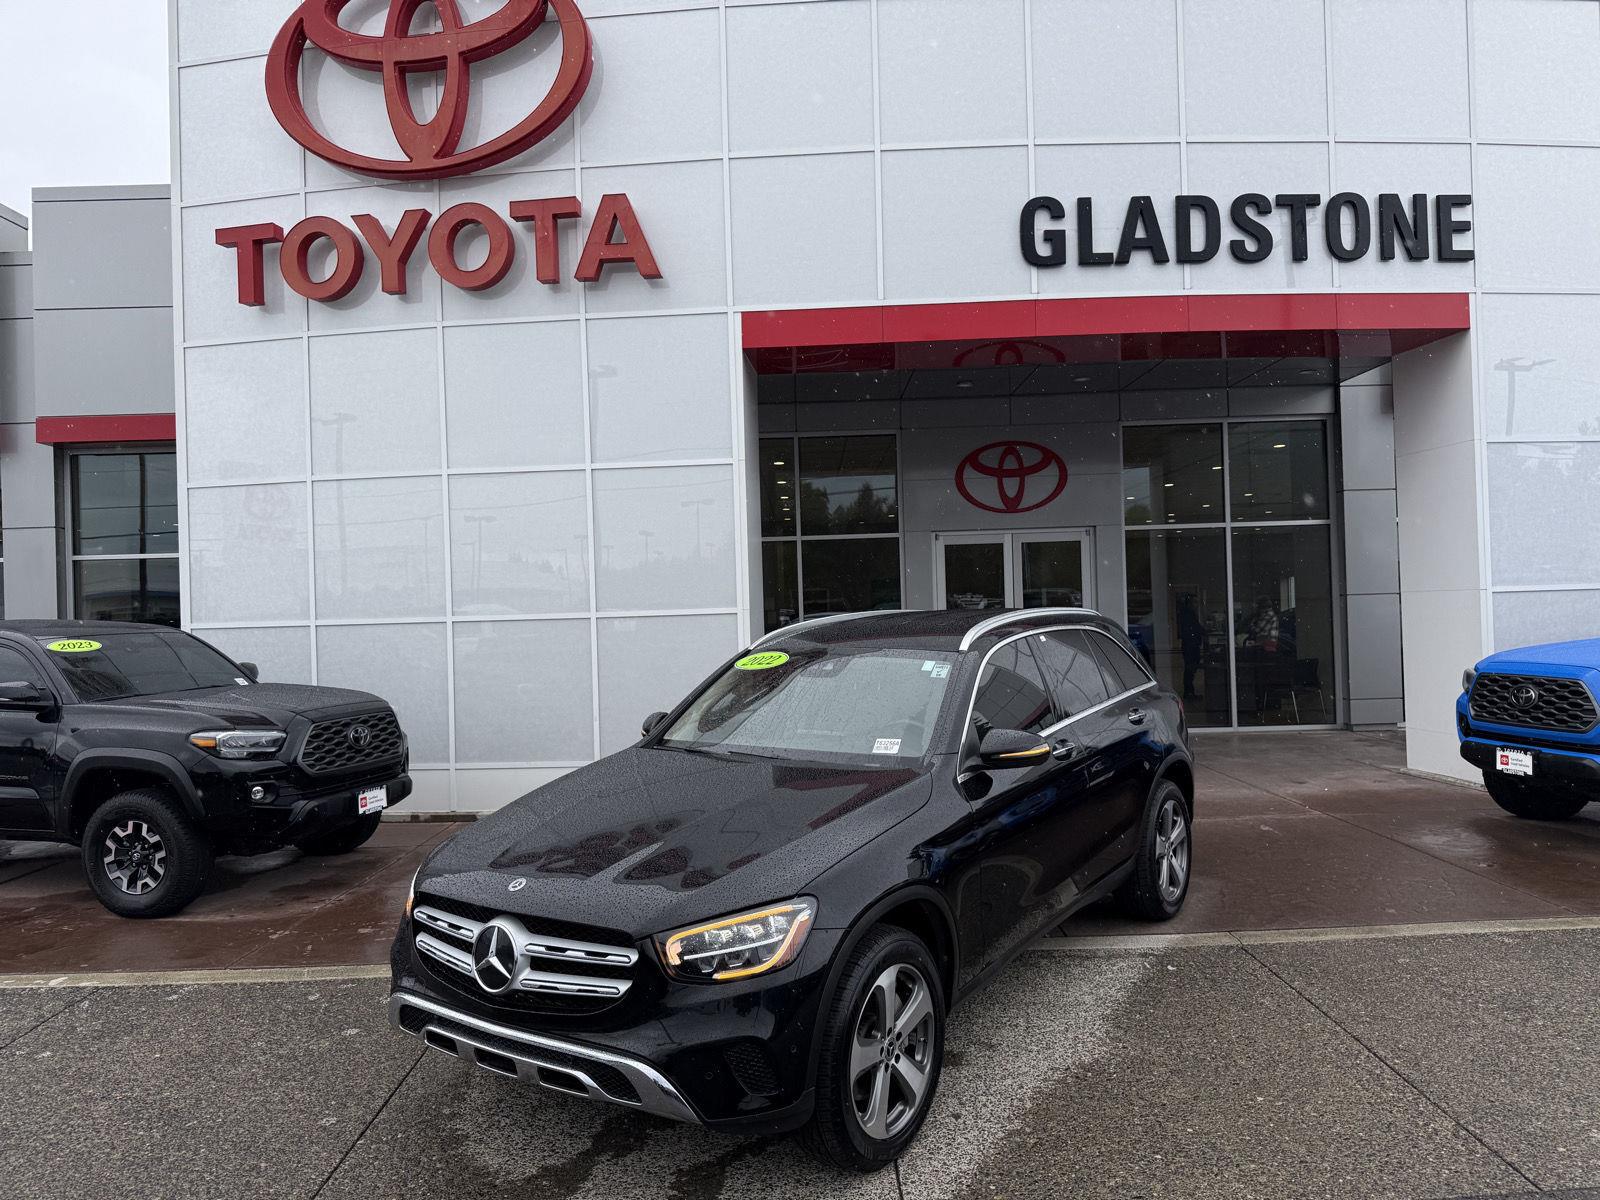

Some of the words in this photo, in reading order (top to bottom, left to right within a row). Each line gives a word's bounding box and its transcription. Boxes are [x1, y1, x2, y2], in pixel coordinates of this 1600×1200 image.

[215, 193, 663, 307] TOYOTA
[1019, 192, 1475, 268] GLADSTONE
[58, 641, 93, 650] 2023
[741, 655, 783, 666] 2022
